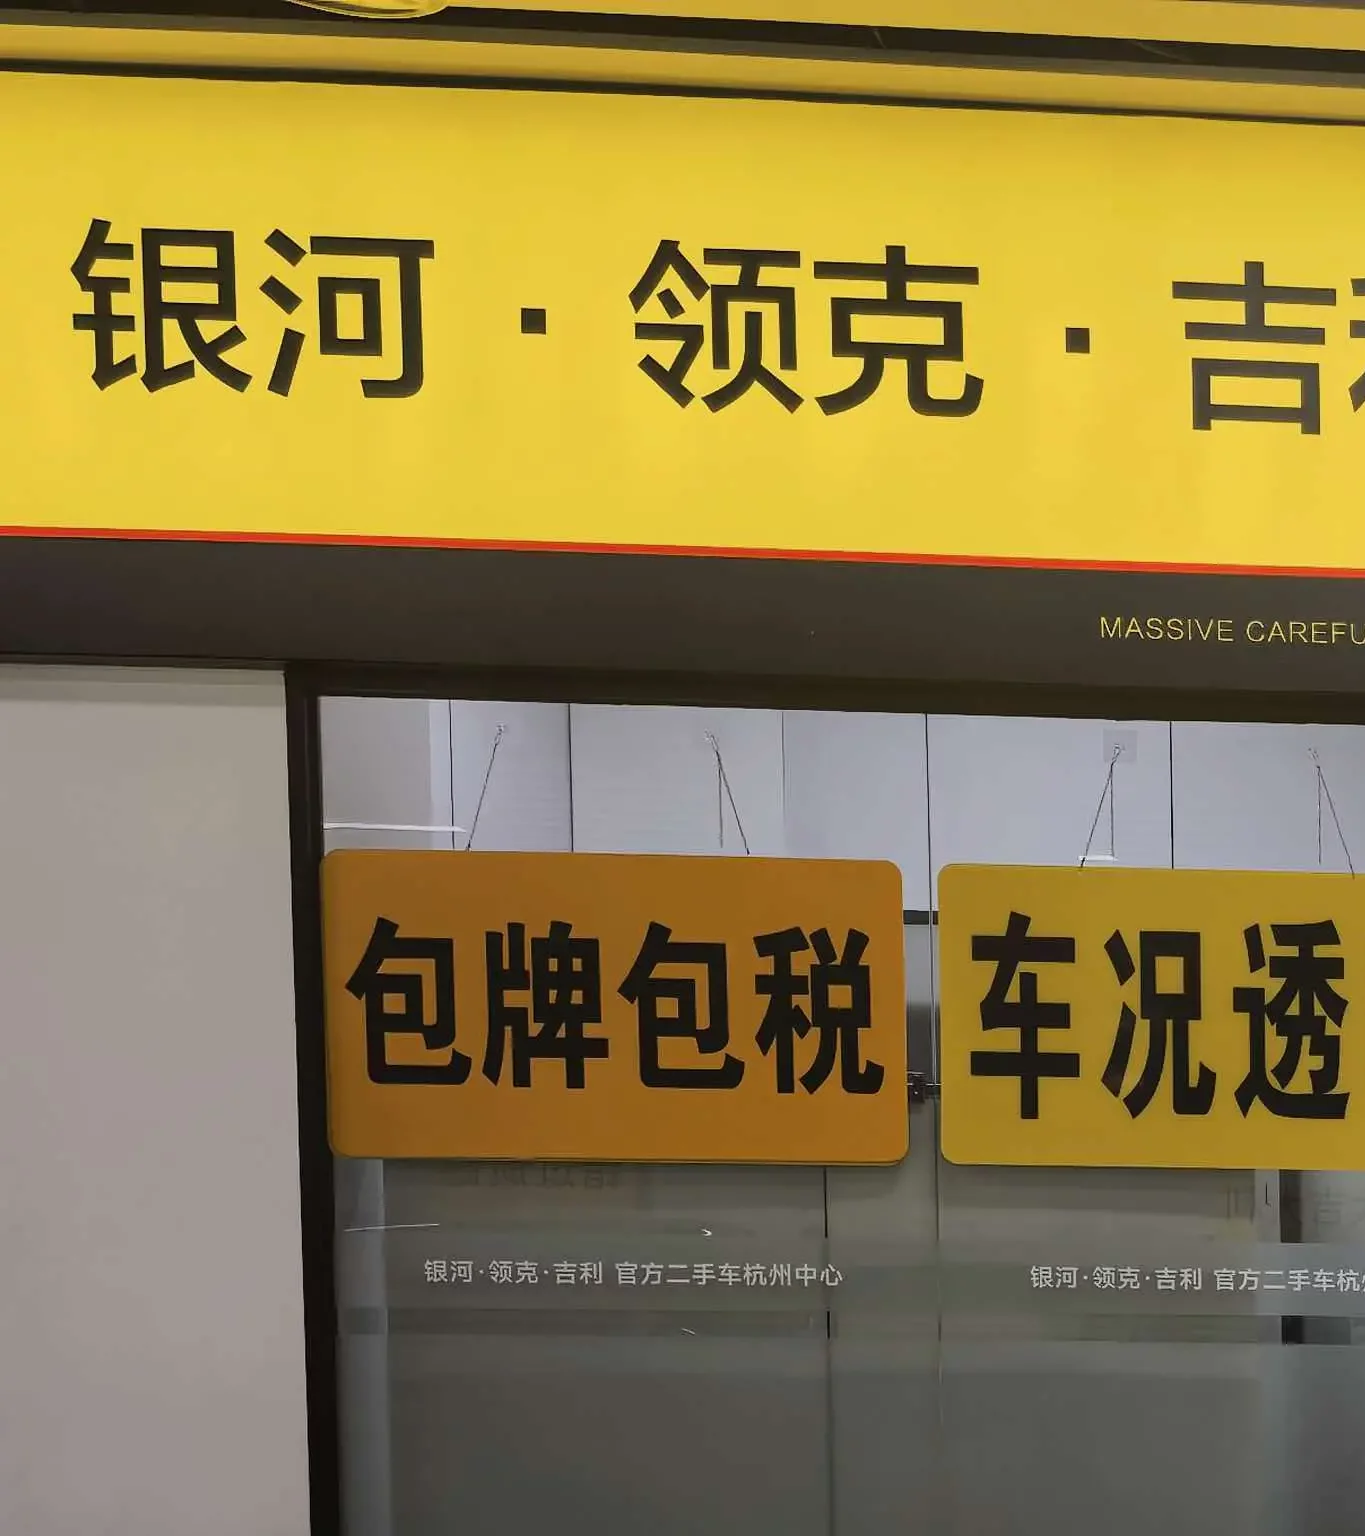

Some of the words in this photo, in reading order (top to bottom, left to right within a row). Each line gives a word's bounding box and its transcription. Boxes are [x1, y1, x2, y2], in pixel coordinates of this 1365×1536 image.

[1100, 616, 1234, 643] MASSIVE
[345, 916, 885, 1097] 包牌包税
[614, 1262, 843, 1288] 官方二手车杭州中心
